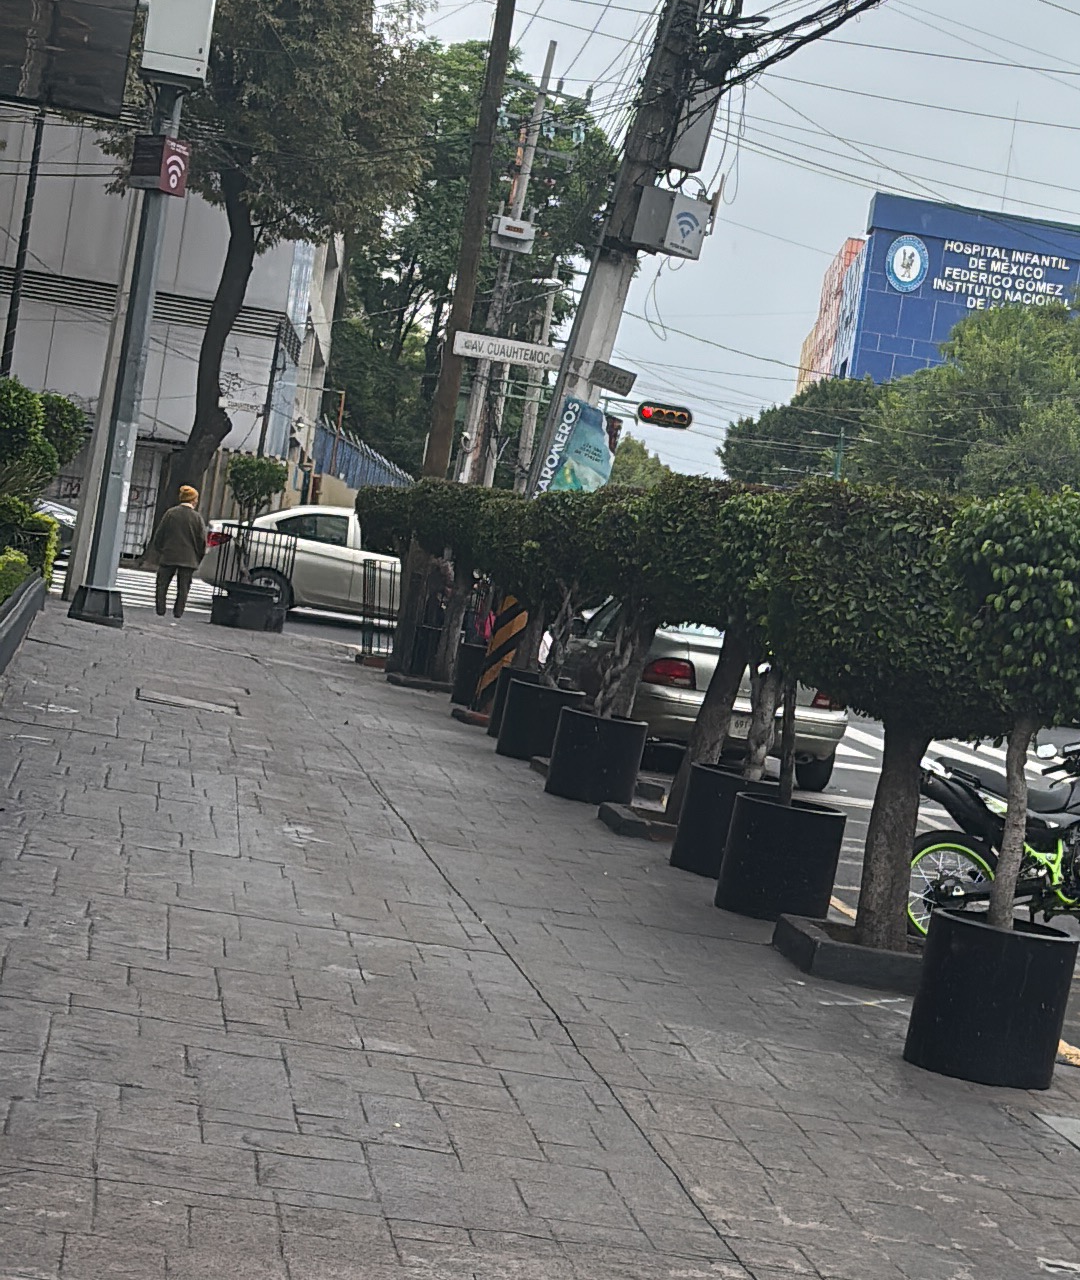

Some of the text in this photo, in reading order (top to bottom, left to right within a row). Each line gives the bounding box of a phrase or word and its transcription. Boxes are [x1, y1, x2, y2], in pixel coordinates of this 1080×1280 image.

[944, 239, 1070, 270] HOSPITAL INFANTIL
[968, 256, 1044, 280] DE MÉXICO
[933, 277, 1002, 299] INSTITUTO
[944, 267, 1064, 296] FEDERICO GÓMEZ
[966, 296, 987, 310] DE
[471, 341, 550, 365] AV. CUAUHTEMOC
